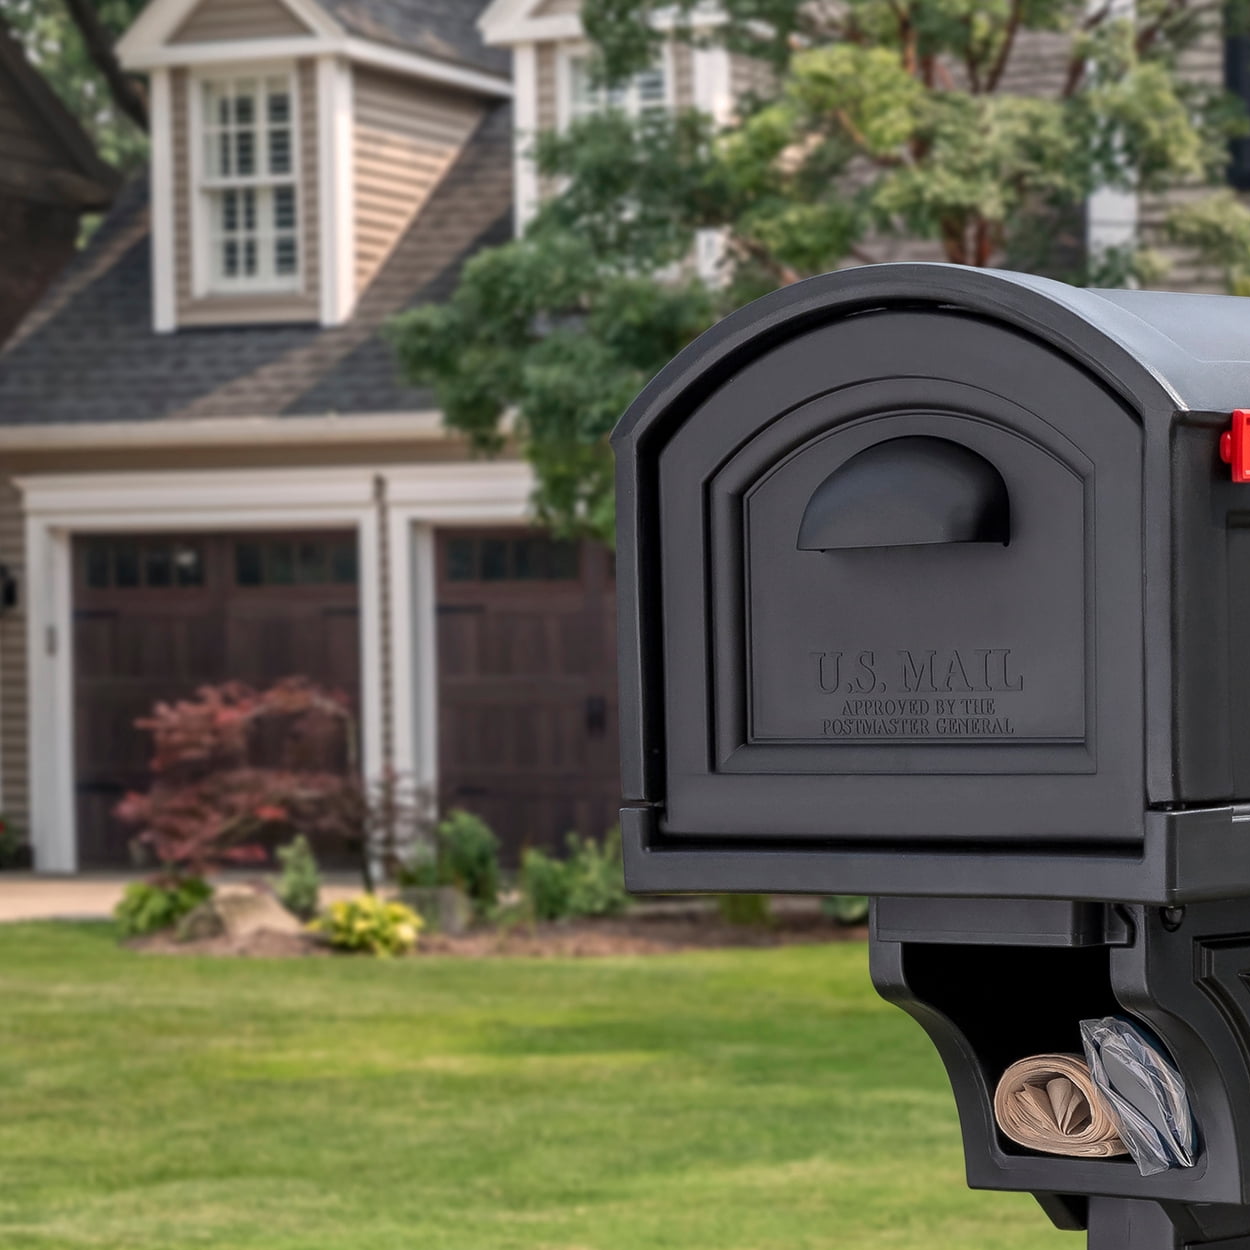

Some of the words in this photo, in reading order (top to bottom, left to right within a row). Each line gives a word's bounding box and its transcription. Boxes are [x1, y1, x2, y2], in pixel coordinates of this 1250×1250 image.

[897, 649, 1024, 693] MAIL
[842, 699, 930, 716] APPROVED
[935, 699, 957, 715] BY
[960, 698, 996, 715] THE
[822, 718, 930, 736] POSTMASTER
[935, 718, 1015, 735] GENERAL
